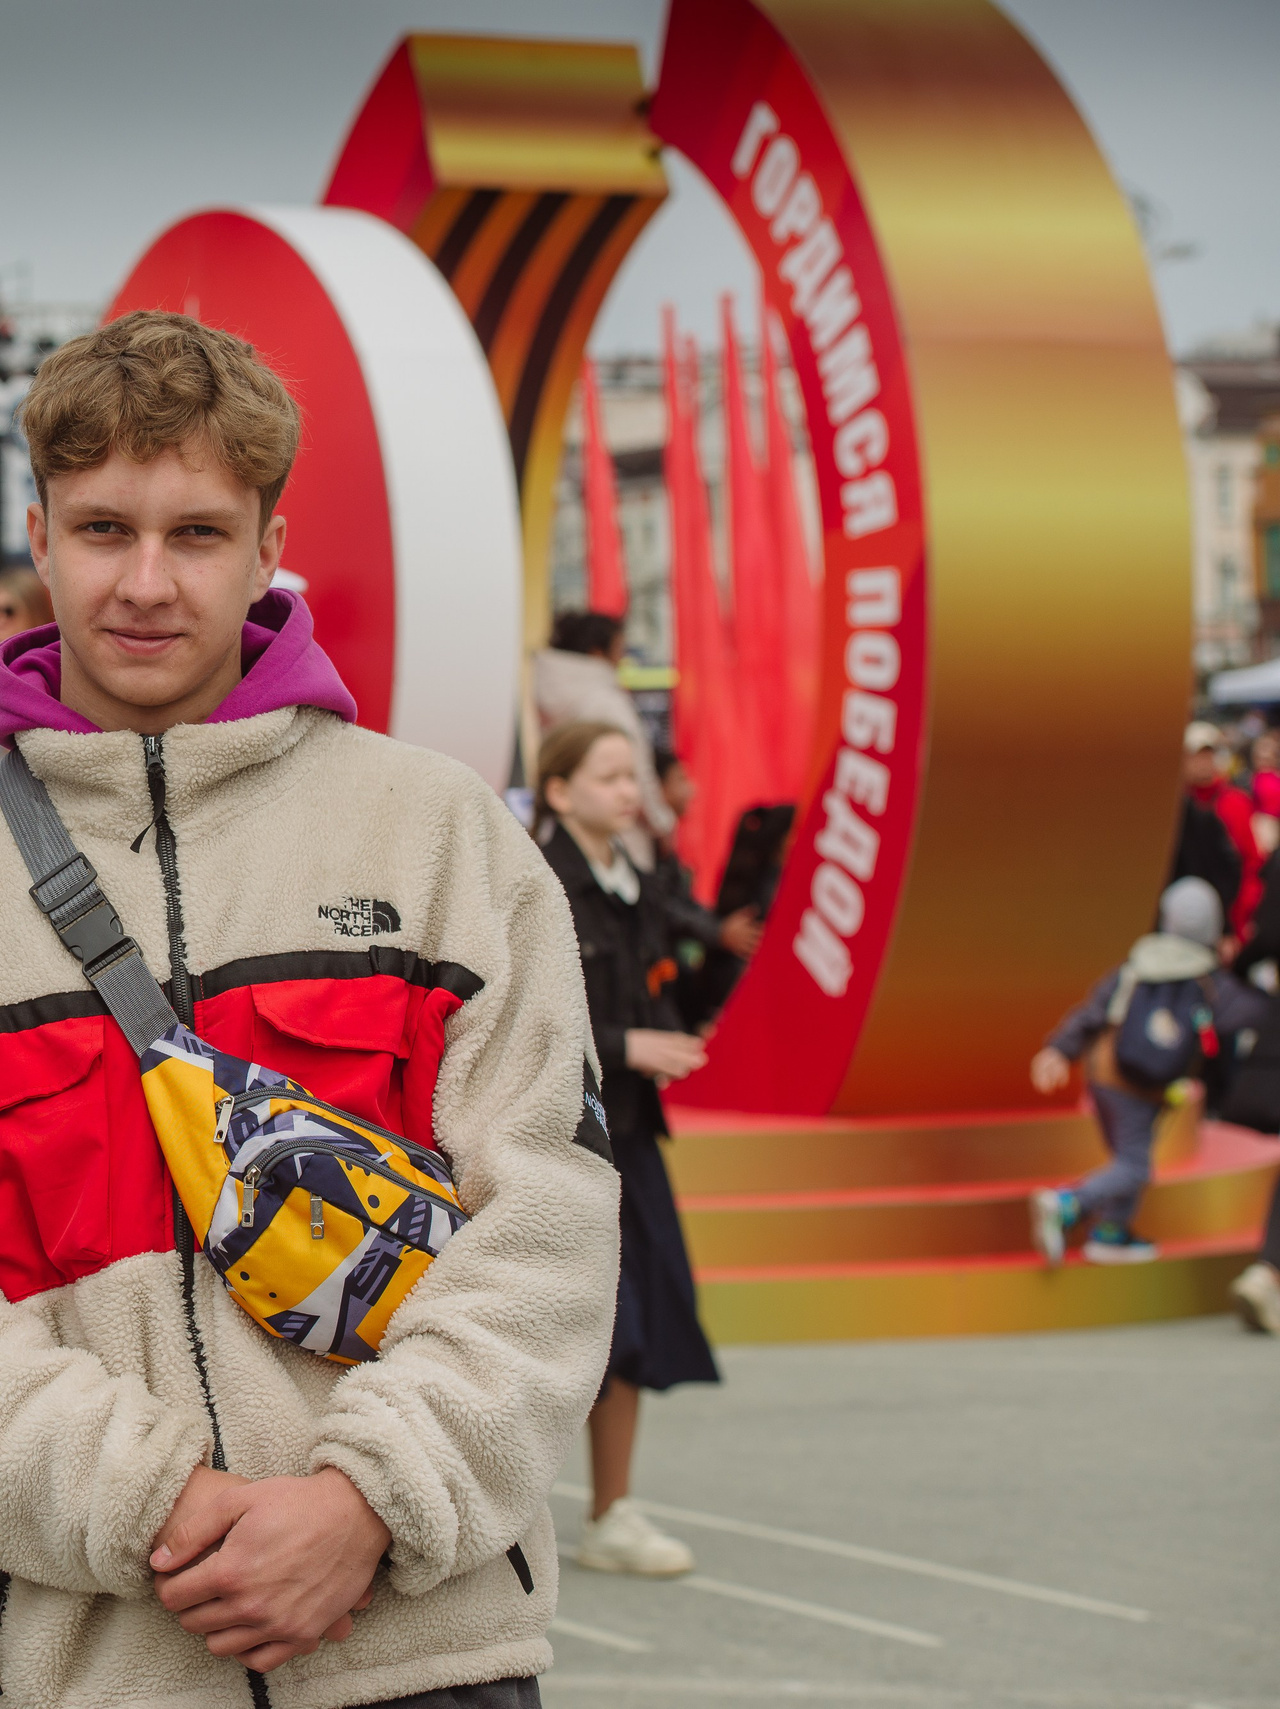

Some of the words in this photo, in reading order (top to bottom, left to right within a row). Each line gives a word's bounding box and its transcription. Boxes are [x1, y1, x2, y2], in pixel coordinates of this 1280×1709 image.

[730, 100, 898, 539] ГОРДИМСЯ
[792, 565, 902, 998] ПОБЕДОЙ
[318, 904, 371, 924] NORTH
[342, 897, 370, 911] THE
[334, 921, 372, 937] FACE
